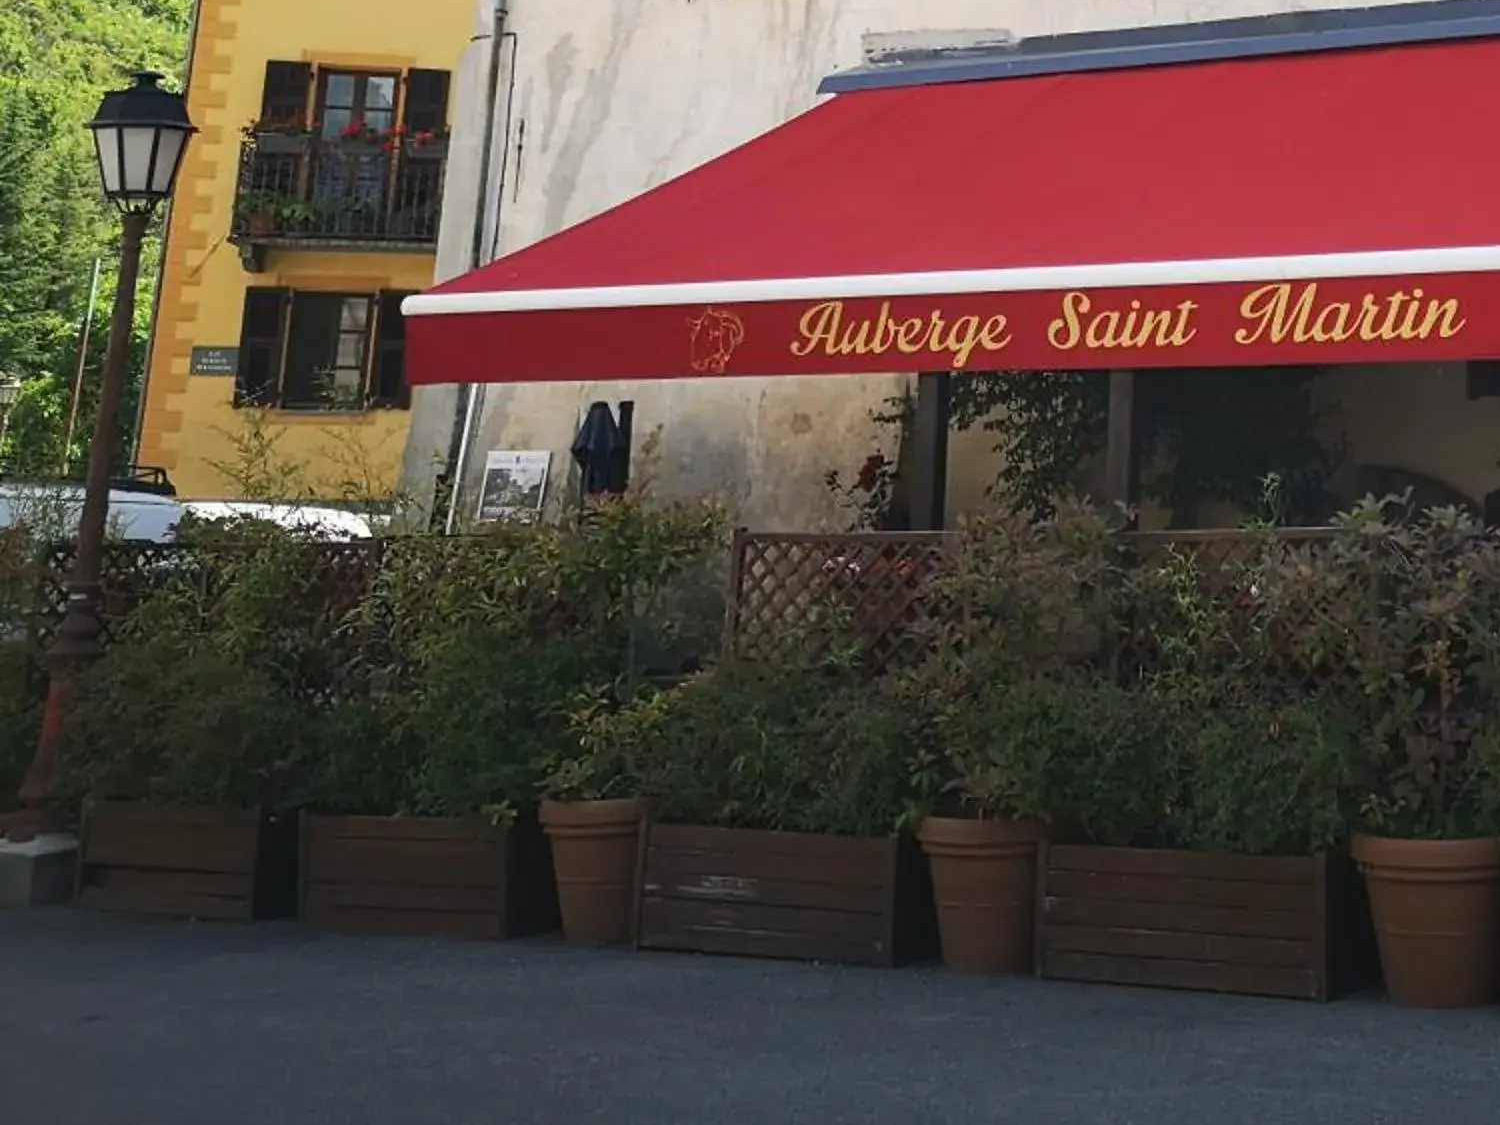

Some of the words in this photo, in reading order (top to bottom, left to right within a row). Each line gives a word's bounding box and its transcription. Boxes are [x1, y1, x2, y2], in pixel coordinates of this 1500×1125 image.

[790, 301, 1012, 368] Auberge
[1047, 292, 1197, 349] Saint
[1235, 283, 1465, 344] Martin
